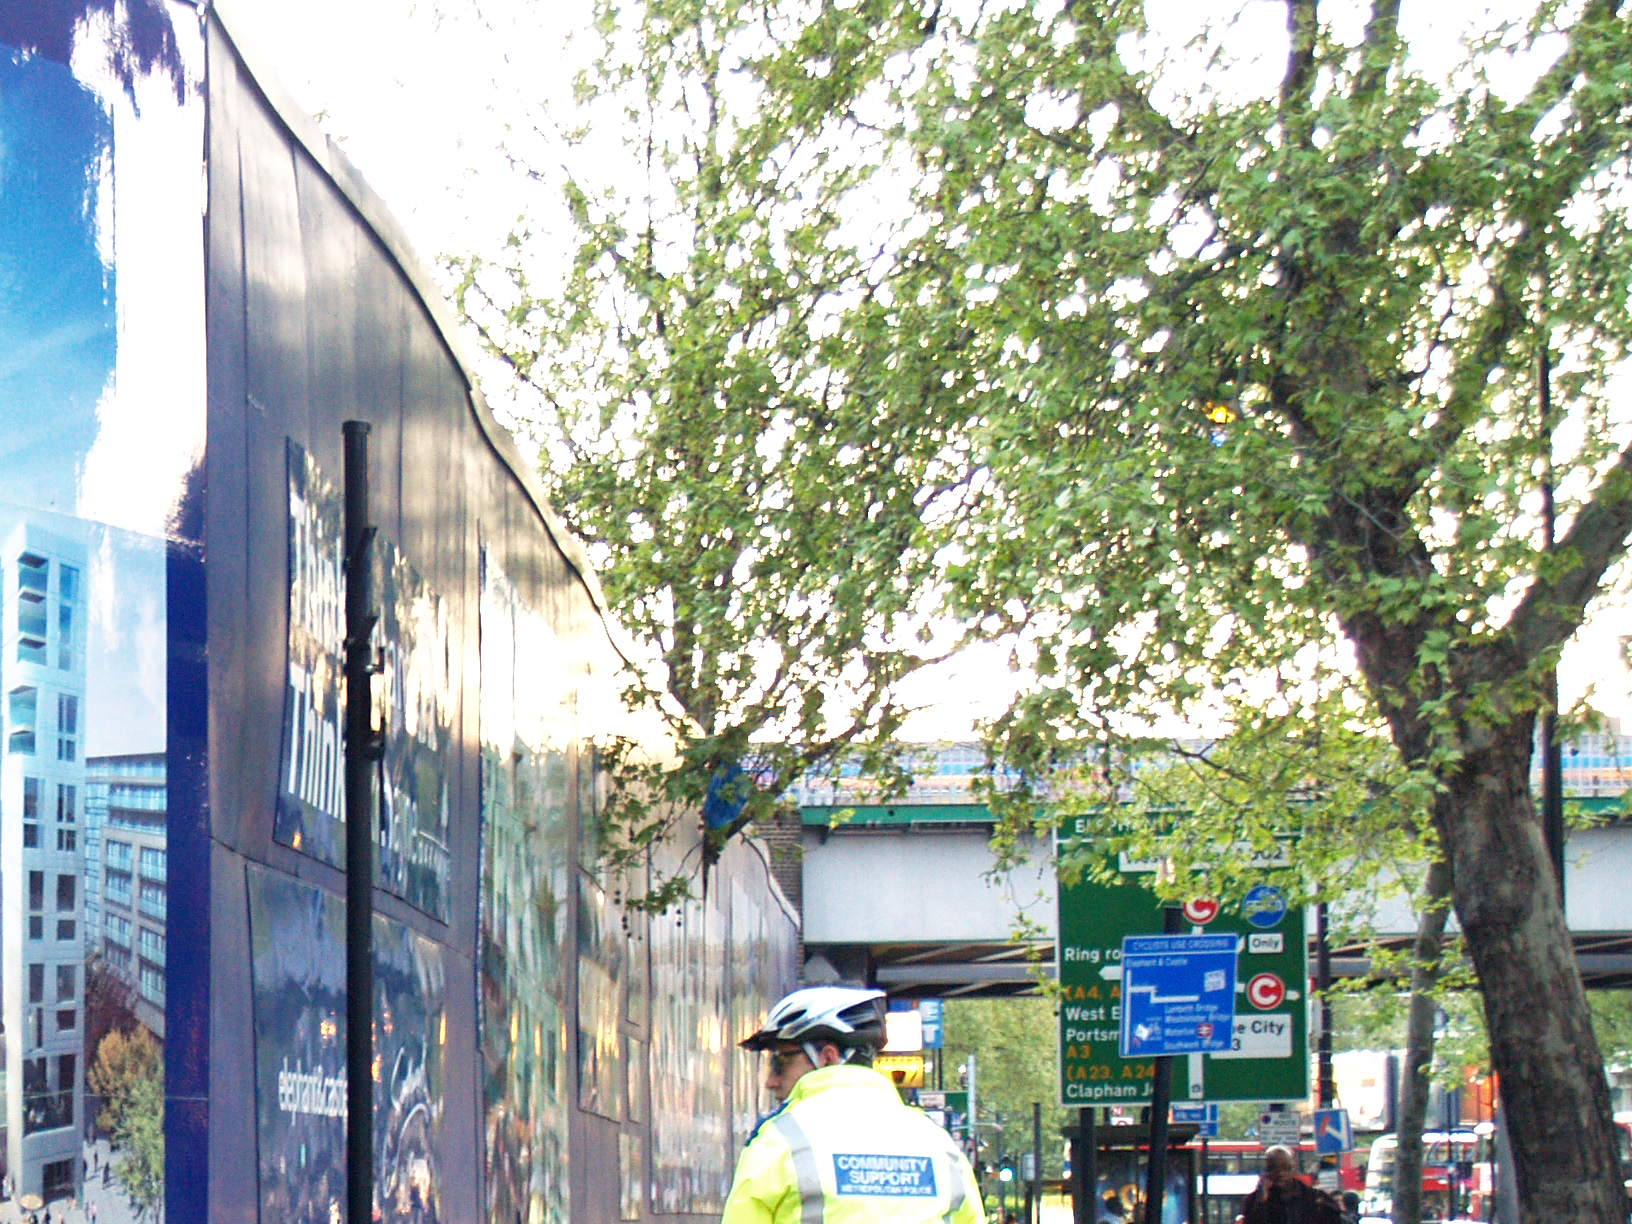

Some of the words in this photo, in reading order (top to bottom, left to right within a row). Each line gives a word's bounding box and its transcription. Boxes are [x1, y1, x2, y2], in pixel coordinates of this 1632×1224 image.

[1252, 937, 1280, 949] Only
[1064, 947, 1100, 963] Ring
[1105, 949, 1122, 961] ro
[1065, 1006, 1106, 1021] West
[1066, 1028, 1120, 1042] Portsm
[1251, 1020, 1284, 1036] City
[1067, 1045, 1092, 1059] A3
[1067, 1083, 1137, 1100] Clapham
[838, 1156, 928, 1172] COMMUNITY
[848, 1171, 921, 1186] SUPPORT
